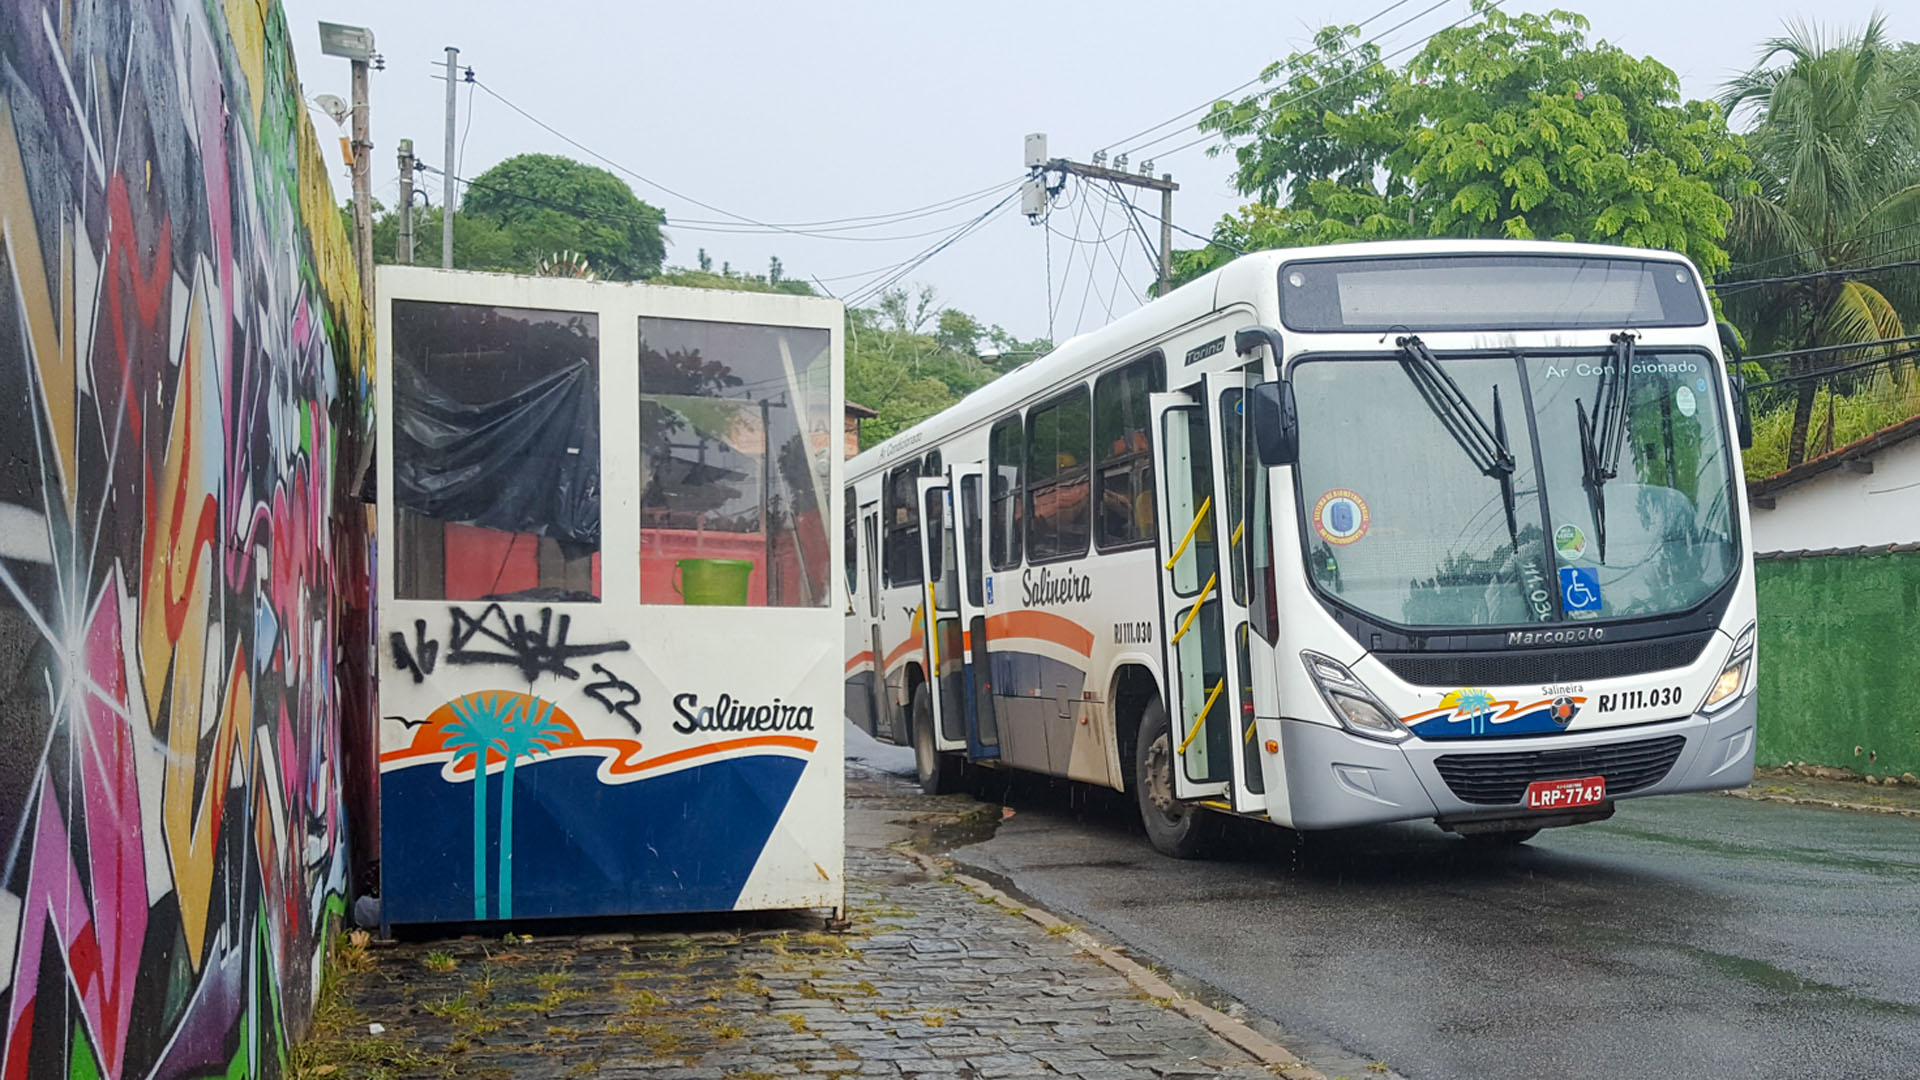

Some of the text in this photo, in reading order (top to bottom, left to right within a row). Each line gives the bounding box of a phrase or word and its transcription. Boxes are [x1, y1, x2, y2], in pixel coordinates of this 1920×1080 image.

[1187, 341, 1224, 364] Torino
[1546, 360, 1698, 379] Ar Concionado
[1022, 566, 1093, 608] Salineira
[1508, 627, 1604, 645] Marcopolo
[1541, 684, 1584, 696] Salineira
[672, 693, 815, 735] Salineira
